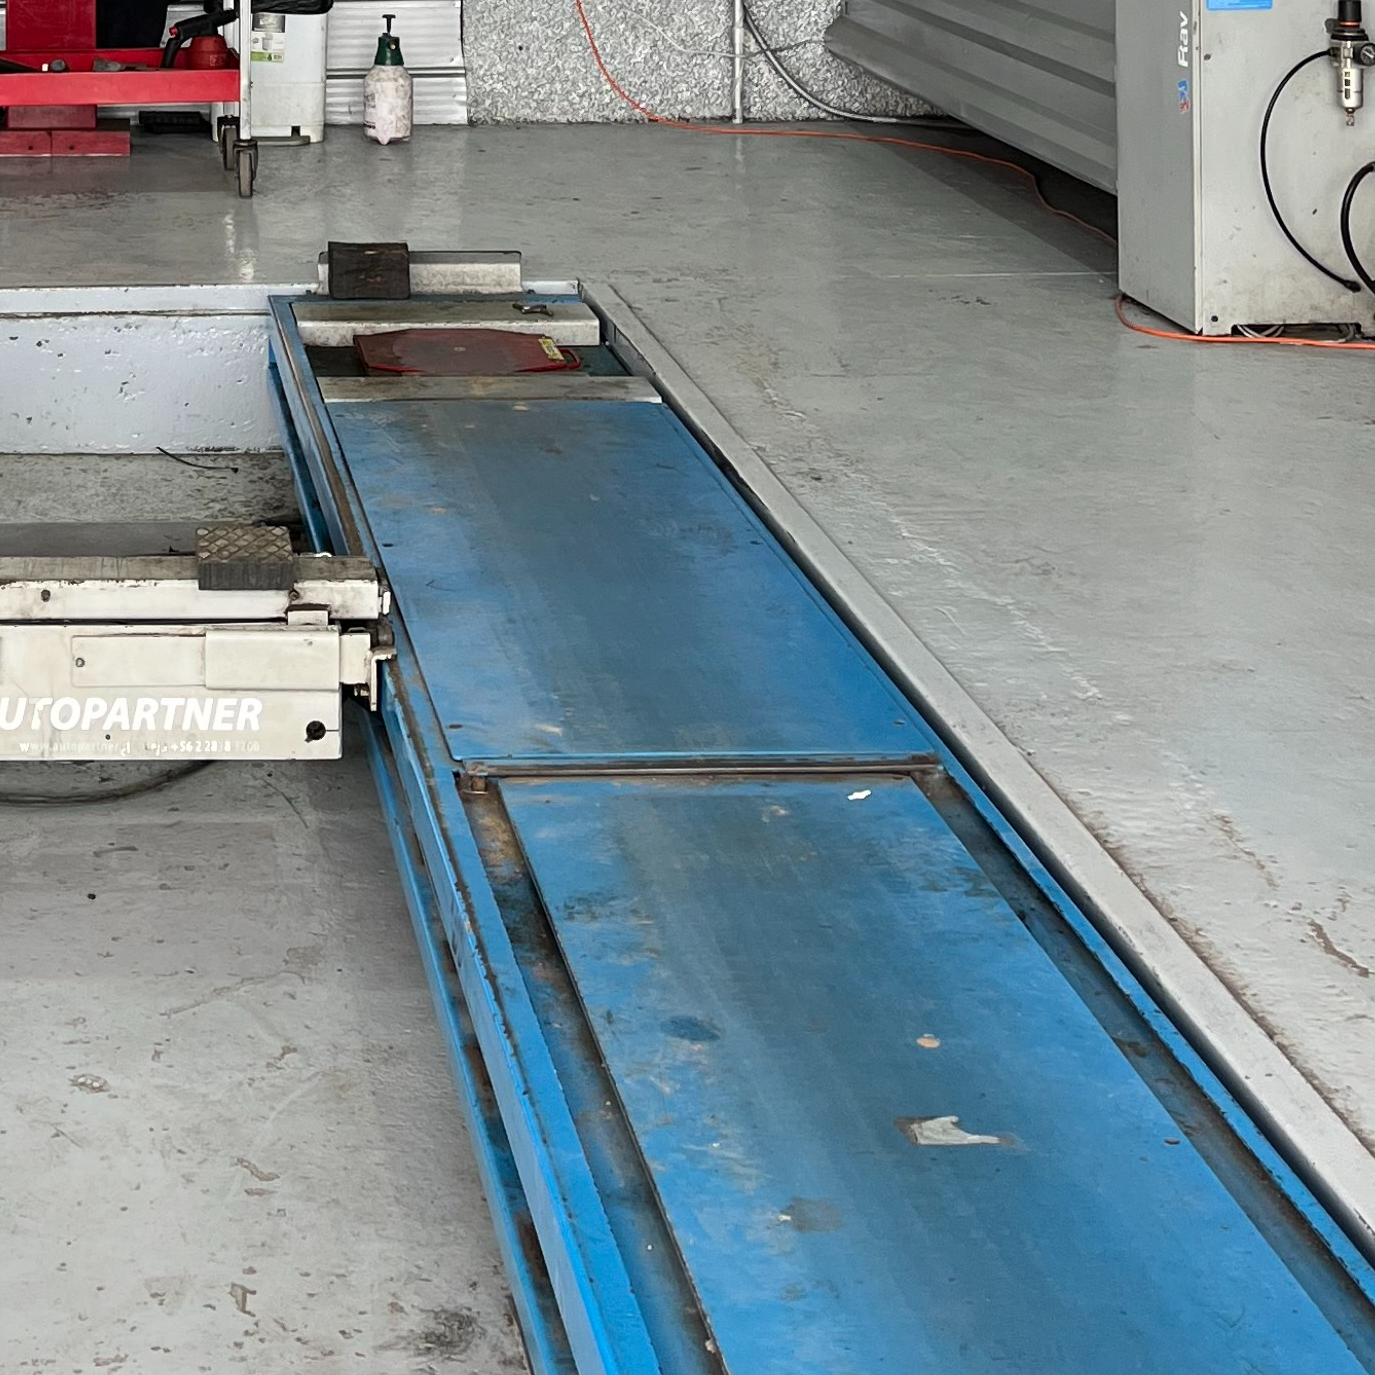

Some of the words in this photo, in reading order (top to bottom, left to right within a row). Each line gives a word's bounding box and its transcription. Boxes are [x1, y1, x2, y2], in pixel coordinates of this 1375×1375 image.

[1177, 11, 1189, 67] Rav
[170, 740, 193, 753] +56
[194, 740, 202, 753] 2
